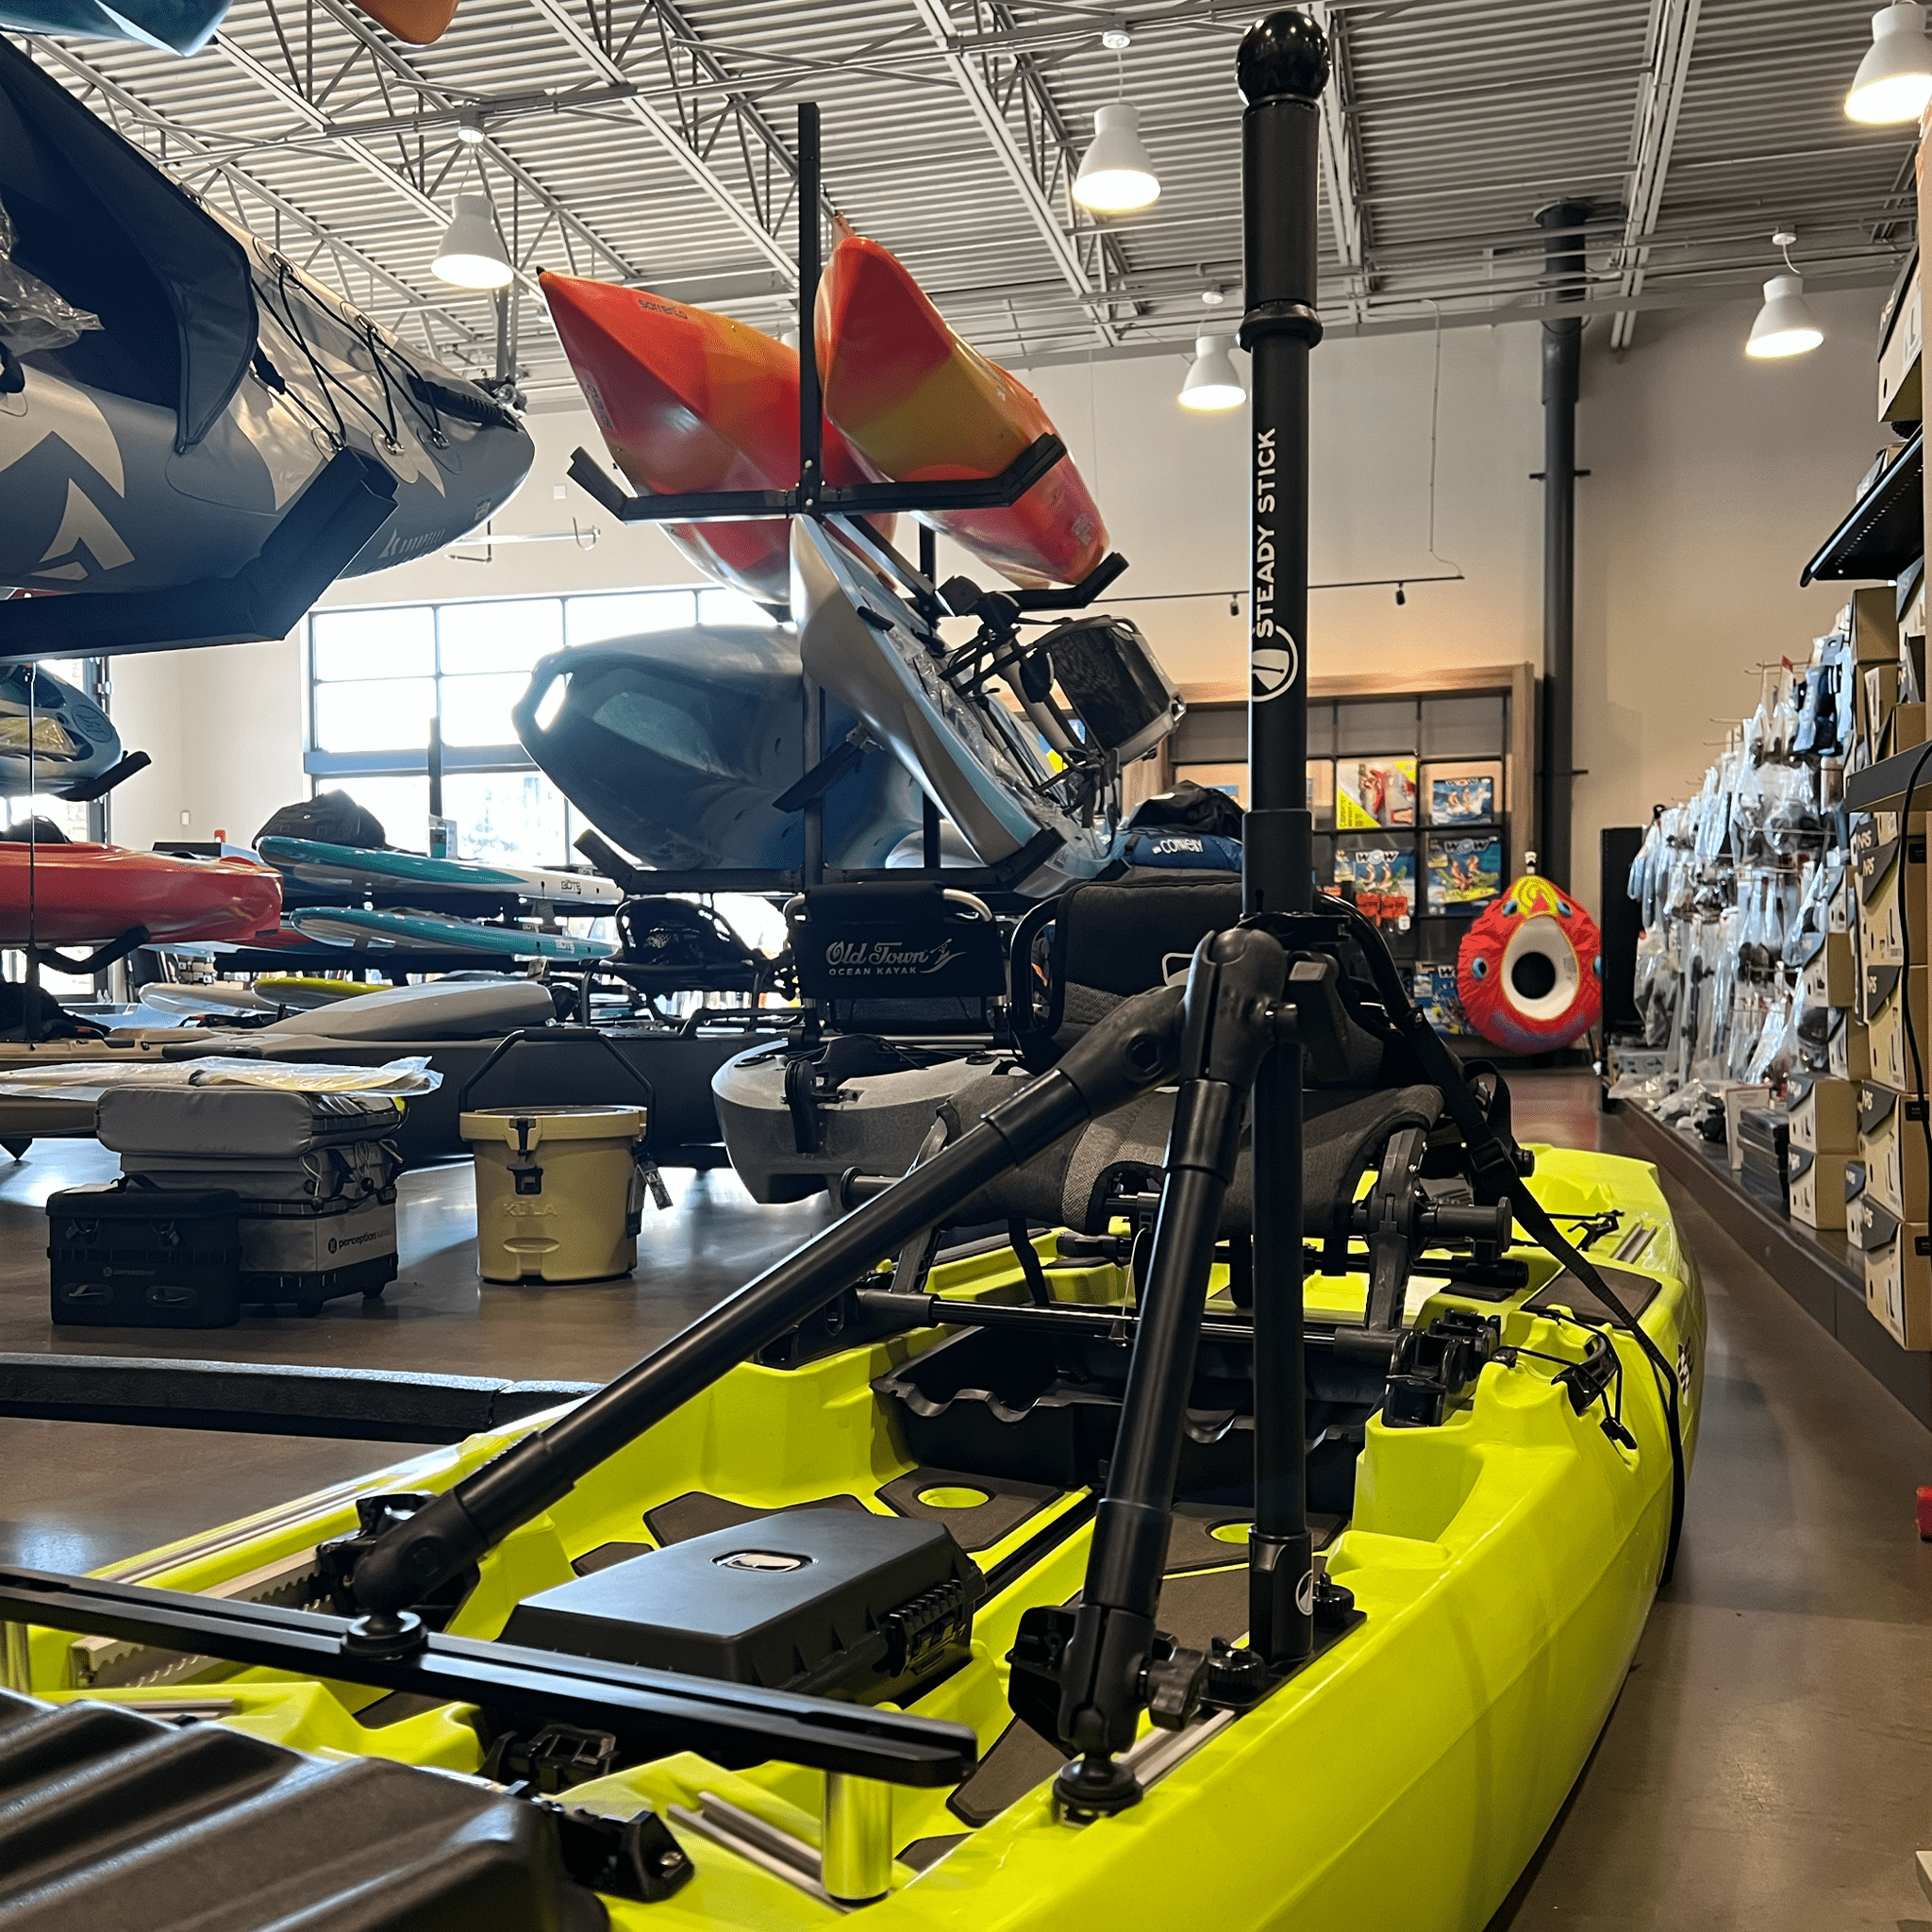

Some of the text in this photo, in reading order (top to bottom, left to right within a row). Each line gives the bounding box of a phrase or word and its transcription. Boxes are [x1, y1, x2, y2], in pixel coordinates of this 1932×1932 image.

[1256, 427, 1275, 638] STEADY STICK
[1355, 849, 1400, 865] WOW
[825, 941, 929, 966] Old Town
[828, 966, 917, 976] OCEAN KAYAK
[339, 1231, 377, 1251] perception
